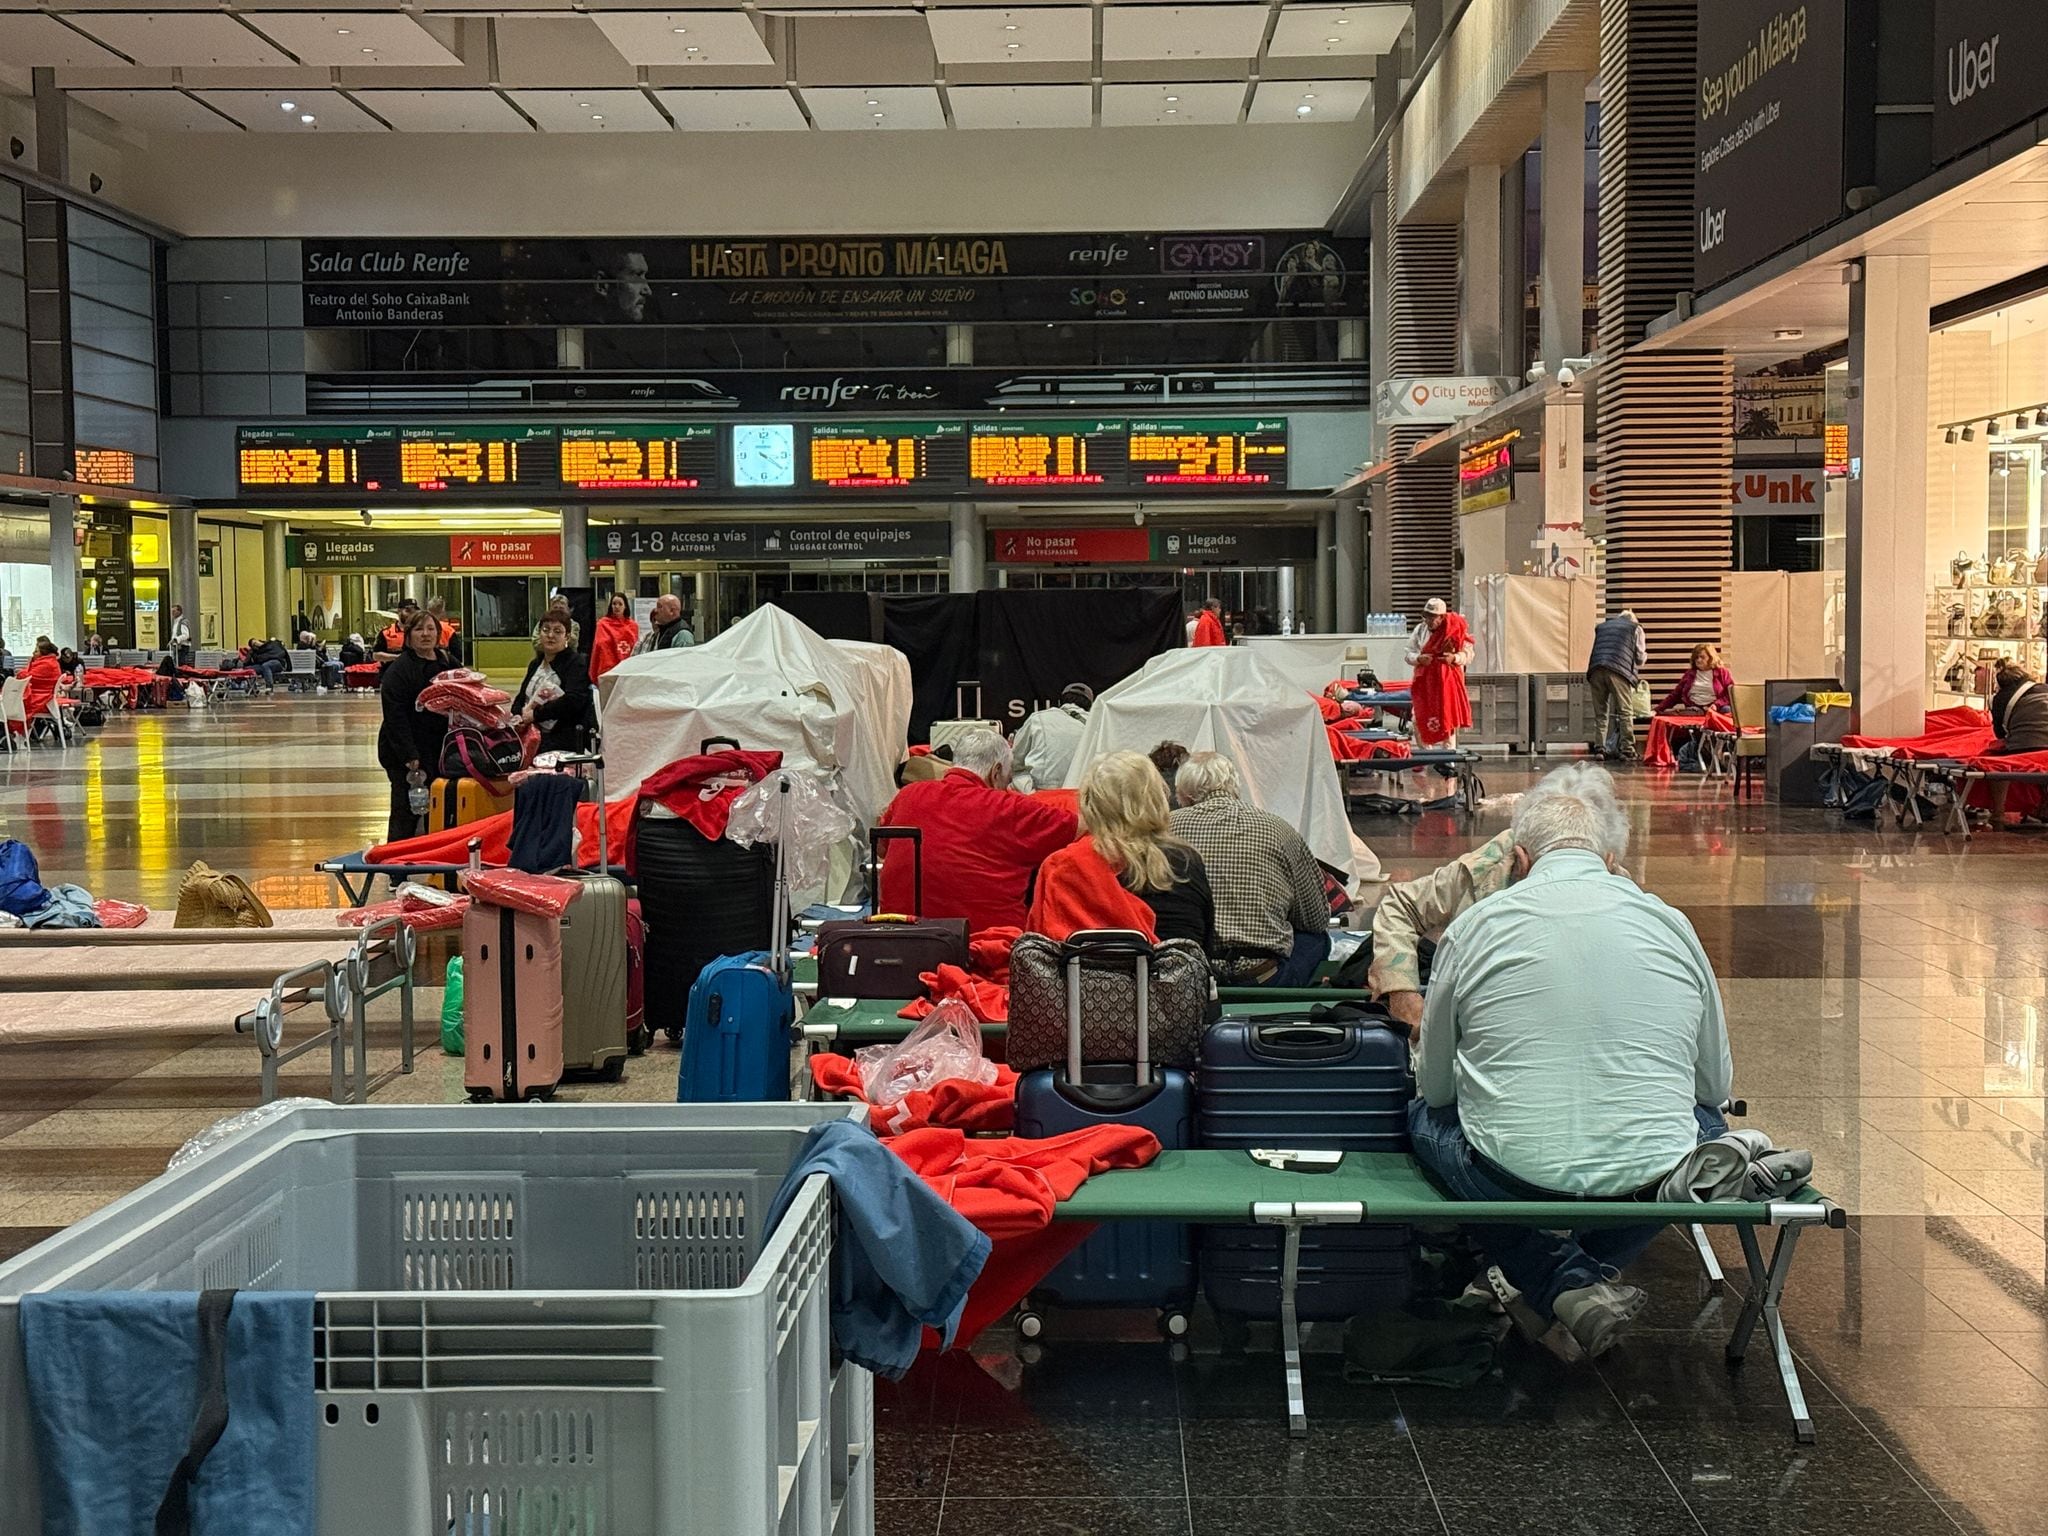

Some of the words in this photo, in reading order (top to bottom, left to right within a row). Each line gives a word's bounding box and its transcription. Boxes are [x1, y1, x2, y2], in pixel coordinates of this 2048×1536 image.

[1702, 77, 1723, 120] See
[1724, 56, 1746, 116] you
[1747, 40, 1758, 86] in
[1759, 5, 1807, 76] Málaga
[1948, 33, 1999, 106] Uber
[1700, 206, 1727, 253] Uber
[690, 243, 769, 277] HASTA
[780, 242, 886, 277] PRONTO
[896, 236, 1009, 277] MÁLAGA
[1069, 243, 1129, 267] renfe
[1169, 243, 1255, 268] GYPSY
[308, 252, 353, 272] Sala
[360, 252, 406, 272] Club
[412, 252, 471, 277] Renfe
[308, 293, 346, 306] Teatro
[350, 292, 370, 305] del
[372, 292, 403, 305] Soho
[406, 292, 471, 305] CaixaBank
[729, 291, 747, 305] LA
[751, 287, 816, 304] EMOCIÓN
[821, 290, 840, 304] DE
[842, 289, 904, 304] ENSAYAR
[907, 290, 926, 303] UN
[930, 286, 977, 303] SUEÑO
[1168, 289, 1206, 301] ANTONIO
[1207, 287, 1250, 300] BANDERAS
[336, 309, 384, 321] Antonio
[388, 308, 444, 321] Banderas
[631, 387, 656, 398] renfe
[779, 377, 860, 408] renfe
[873, 384, 894, 400] Tu
[1432, 386, 1456, 400] City
[1459, 385, 1498, 399] Expert
[241, 430, 273, 439] Llegadas
[403, 429, 434, 438] Llegadas
[563, 428, 594, 436] Llegadas
[631, 531, 664, 553] 1-8
[671, 531, 710, 542] Acceso
[713, 533, 719, 542] a
[724, 529, 747, 542] vías
[790, 530, 832, 541] Control
[836, 528, 850, 541] de
[854, 529, 911, 543] equipajes
[1026, 537, 1041, 547] No
[1045, 537, 1076, 548] pasar
[1188, 534, 1237, 547] Llegadas
[325, 542, 374, 554] Llegadas
[482, 541, 497, 551] No
[501, 542, 531, 553] pasar
[790, 543, 826, 551] LUGGAGE
[828, 542, 863, 550] CONTROL
